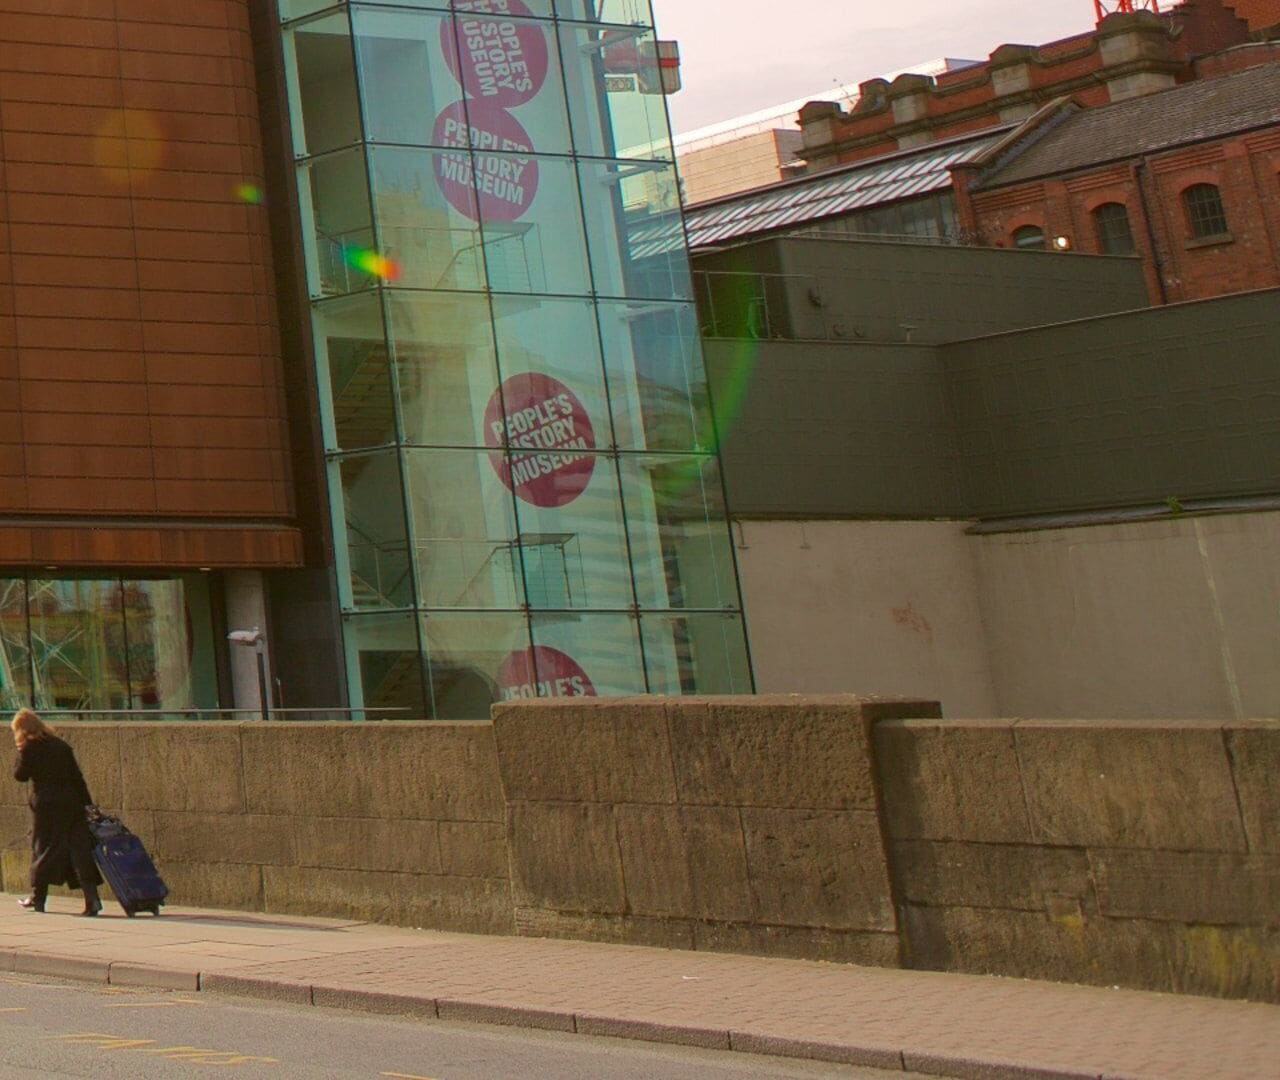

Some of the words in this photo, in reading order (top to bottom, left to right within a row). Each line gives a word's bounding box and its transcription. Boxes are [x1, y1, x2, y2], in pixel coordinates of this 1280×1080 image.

[474, 0, 515, 90] HSTORY
[444, 118, 529, 164] PEOPLE'S
[440, 158, 524, 205] MUSEUM
[490, 393, 574, 442] PEOPLE'S
[504, 416, 576, 464] ISTORY
[511, 436, 587, 487] MUSEUM
